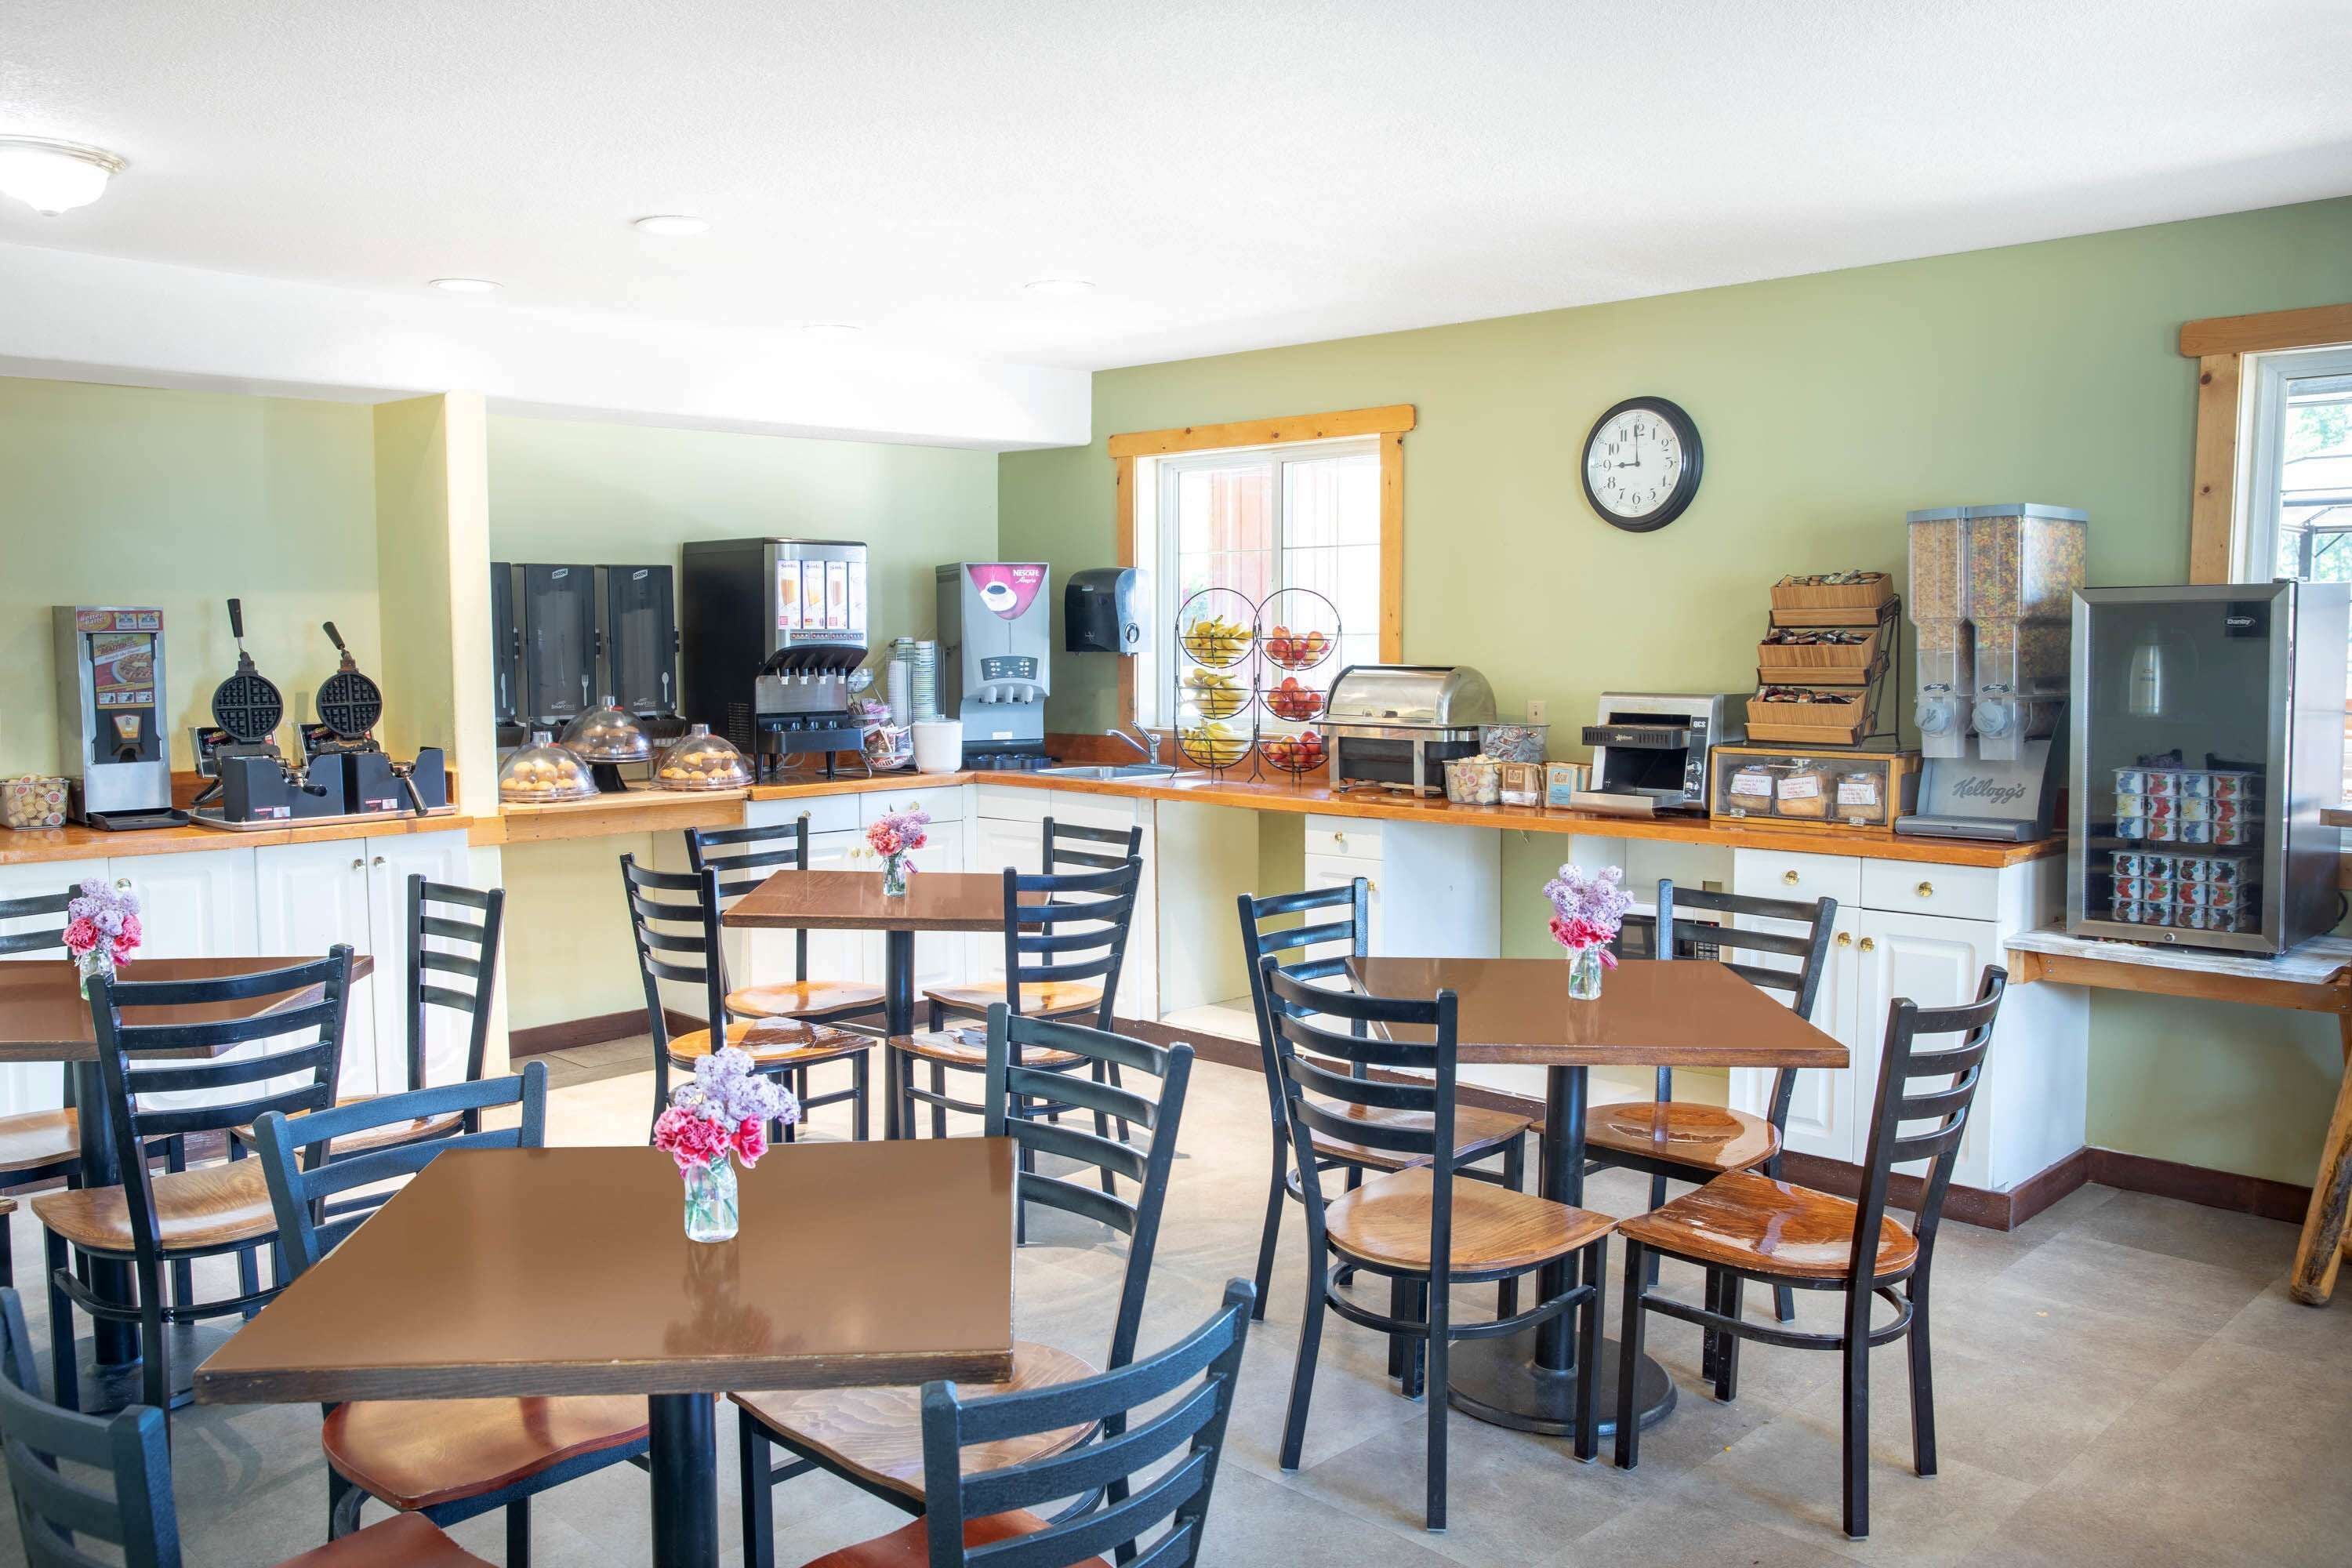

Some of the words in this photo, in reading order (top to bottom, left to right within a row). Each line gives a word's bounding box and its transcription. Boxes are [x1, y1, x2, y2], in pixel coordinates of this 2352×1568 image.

[1620, 430, 1628, 442] 11
[1652, 427, 1656, 441] 1
[1608, 442, 1620, 456] 10
[1661, 438, 1670, 452] 2
[1602, 459, 1612, 471] 9
[1607, 476, 1617, 490] 8
[1619, 488, 1626, 500] 7
[1632, 491, 1642, 506] 6
[1647, 488, 1657, 501] 5
[1952, 776, 2027, 804] Kellogg's
